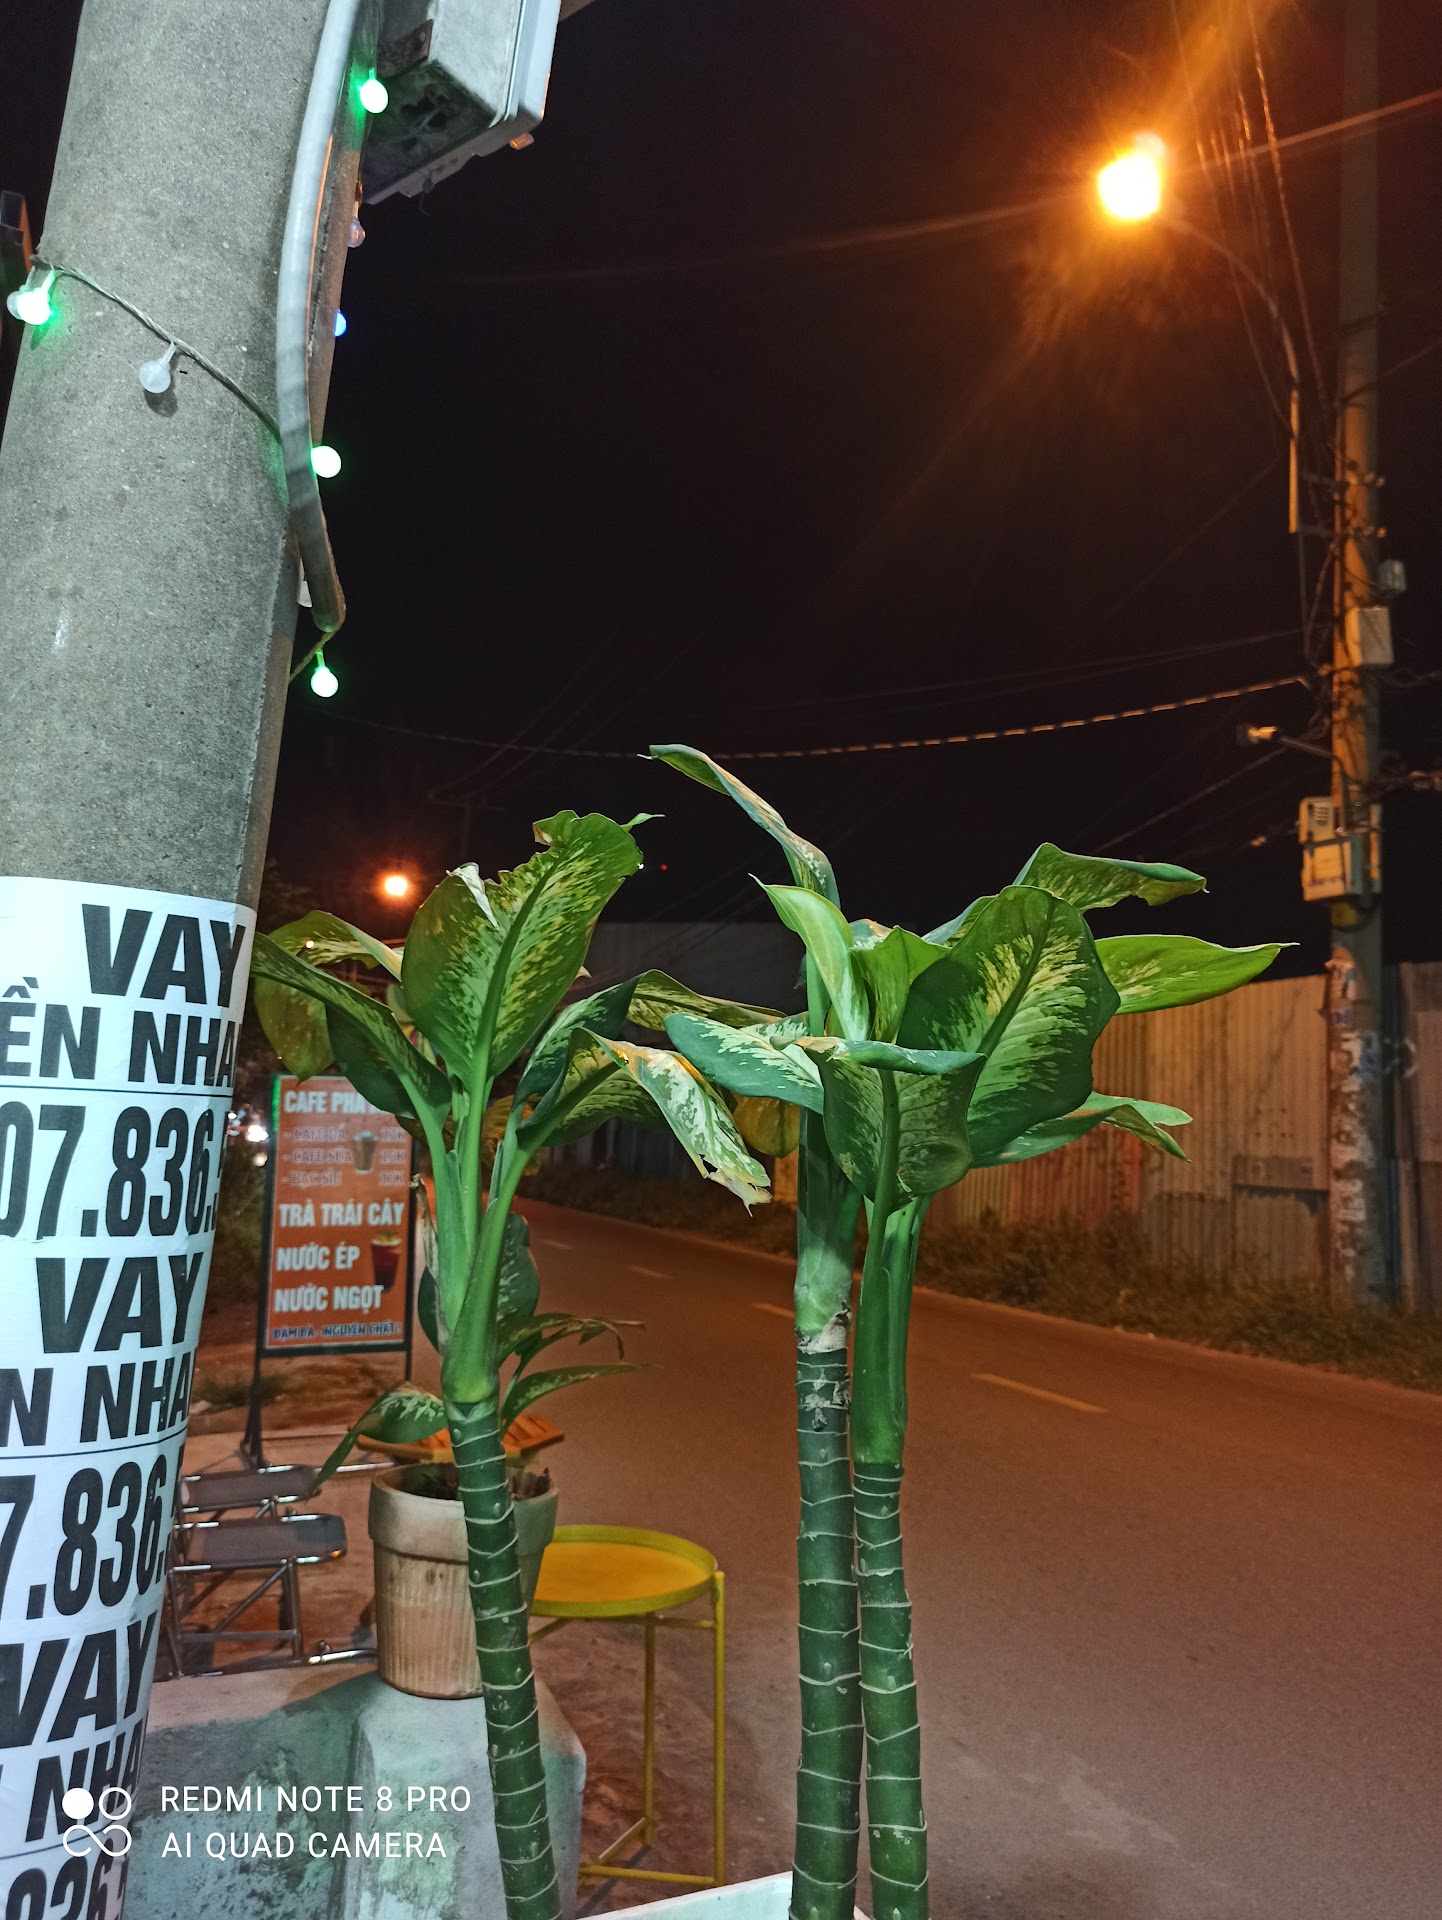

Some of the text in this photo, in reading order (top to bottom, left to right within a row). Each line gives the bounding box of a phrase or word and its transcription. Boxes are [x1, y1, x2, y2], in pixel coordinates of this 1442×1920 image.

[82, 903, 246, 1008] VAY
[128, 1010, 242, 1089] NHA
[284, 1090, 327, 1113] CAFE
[293, 1125, 326, 1143] CAFE
[292, 1148, 326, 1166] CAFE
[279, 1197, 405, 1228] TRÀ TRÁI CÂY
[276, 1241, 361, 1271] NƯỚC ÉP
[36, 1252, 204, 1354] VAY
[274, 1282, 385, 1315] NƯỚC NGỌT
[321, 1321, 367, 1337] NGUYÊN
[80, 1352, 193, 1443] NHA
[0, 1609, 158, 1749] VAY
[25, 1717, 148, 1843] NHA
